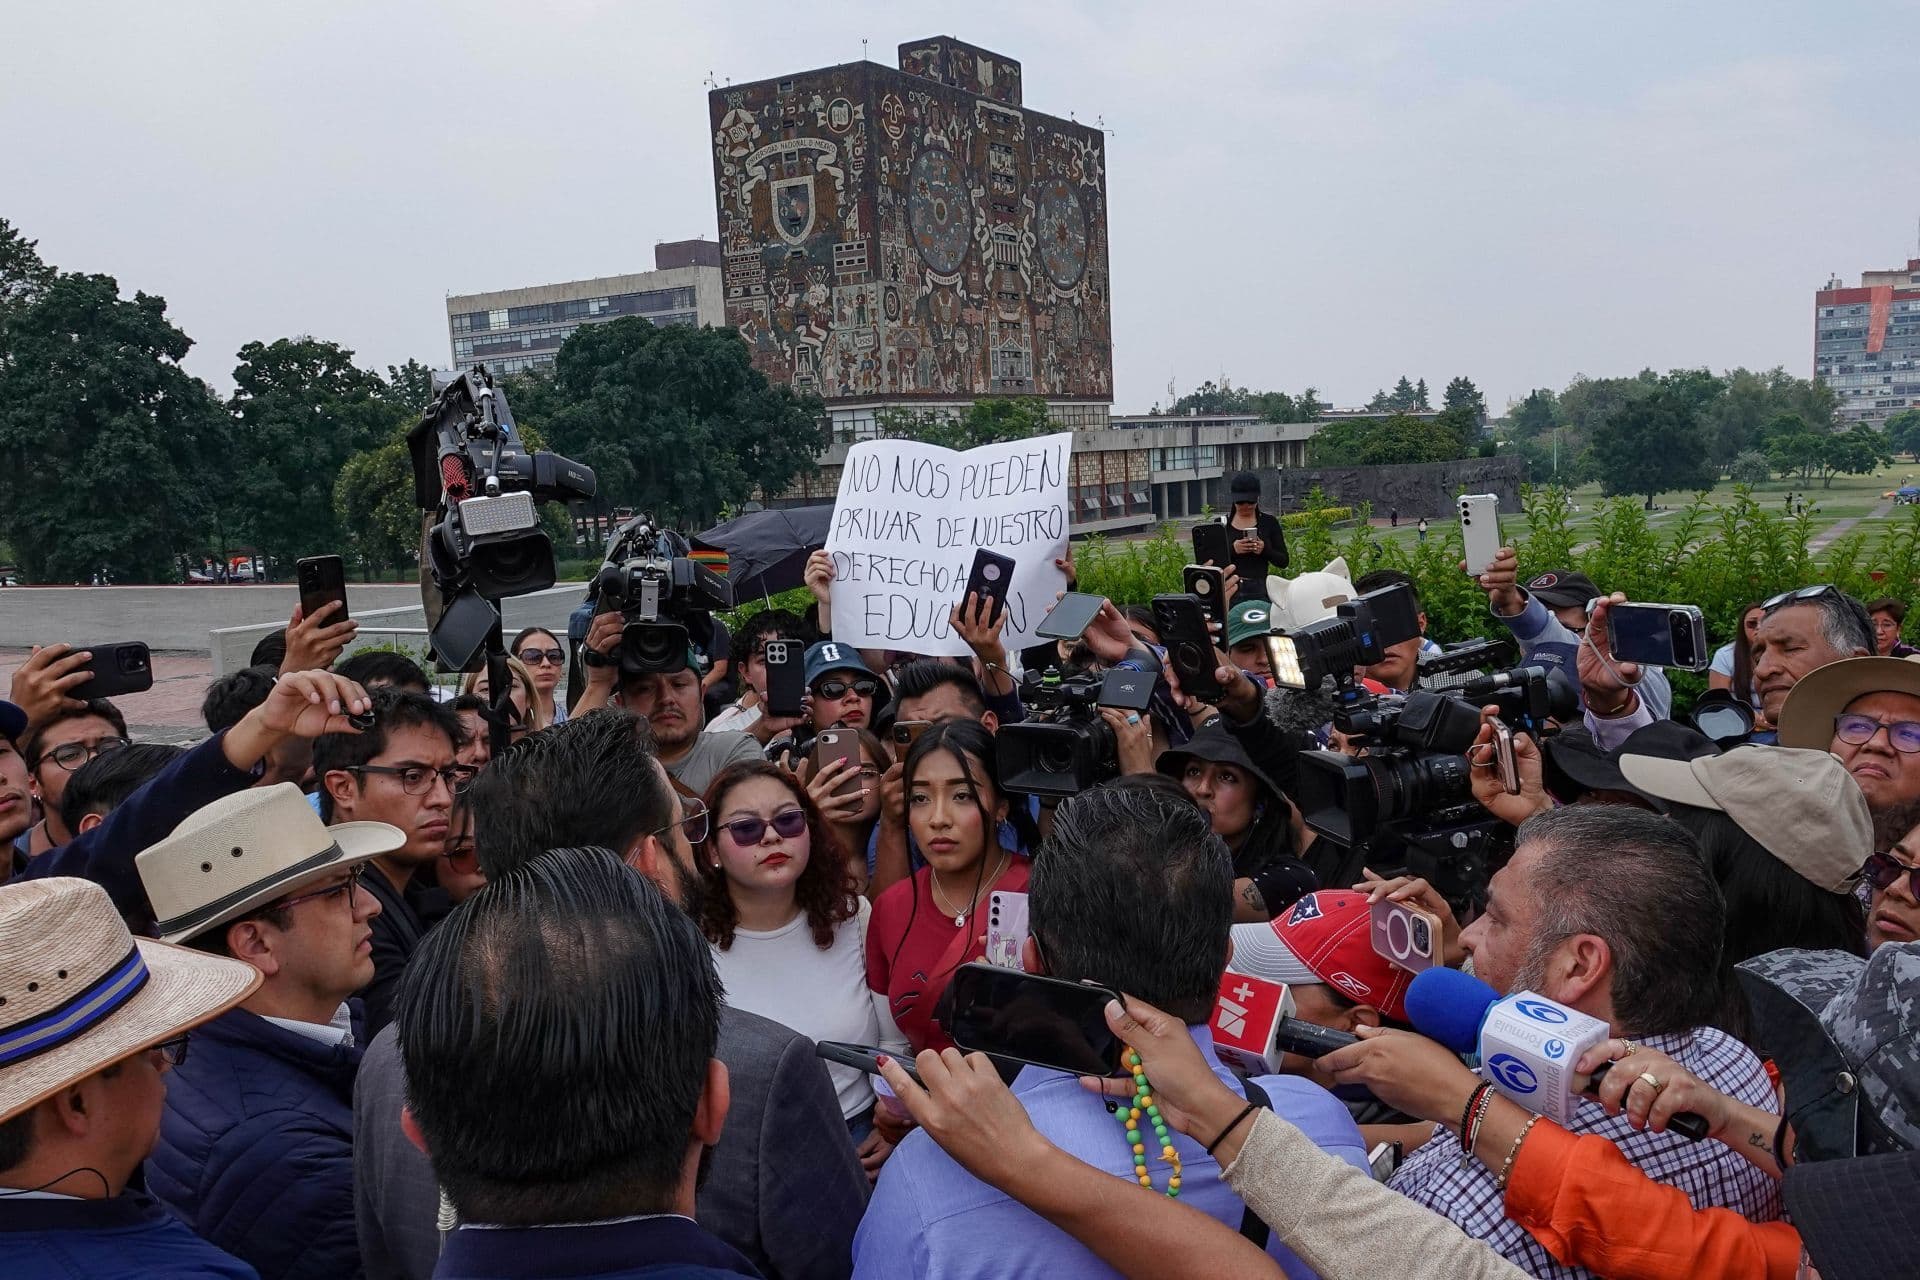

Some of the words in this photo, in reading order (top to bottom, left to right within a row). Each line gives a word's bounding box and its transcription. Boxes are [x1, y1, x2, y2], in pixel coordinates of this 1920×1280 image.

[847, 454, 881, 496] NO
[892, 455, 950, 498] NOS
[960, 444, 1061, 501] PUEDEN
[835, 507, 921, 543] PRIVAR
[936, 517, 966, 548] DE
[970, 504, 1063, 547] NUESTRO
[832, 550, 949, 593] DERECHO
[862, 591, 1027, 641] EDUCN
[1243, 610, 1267, 622] G
